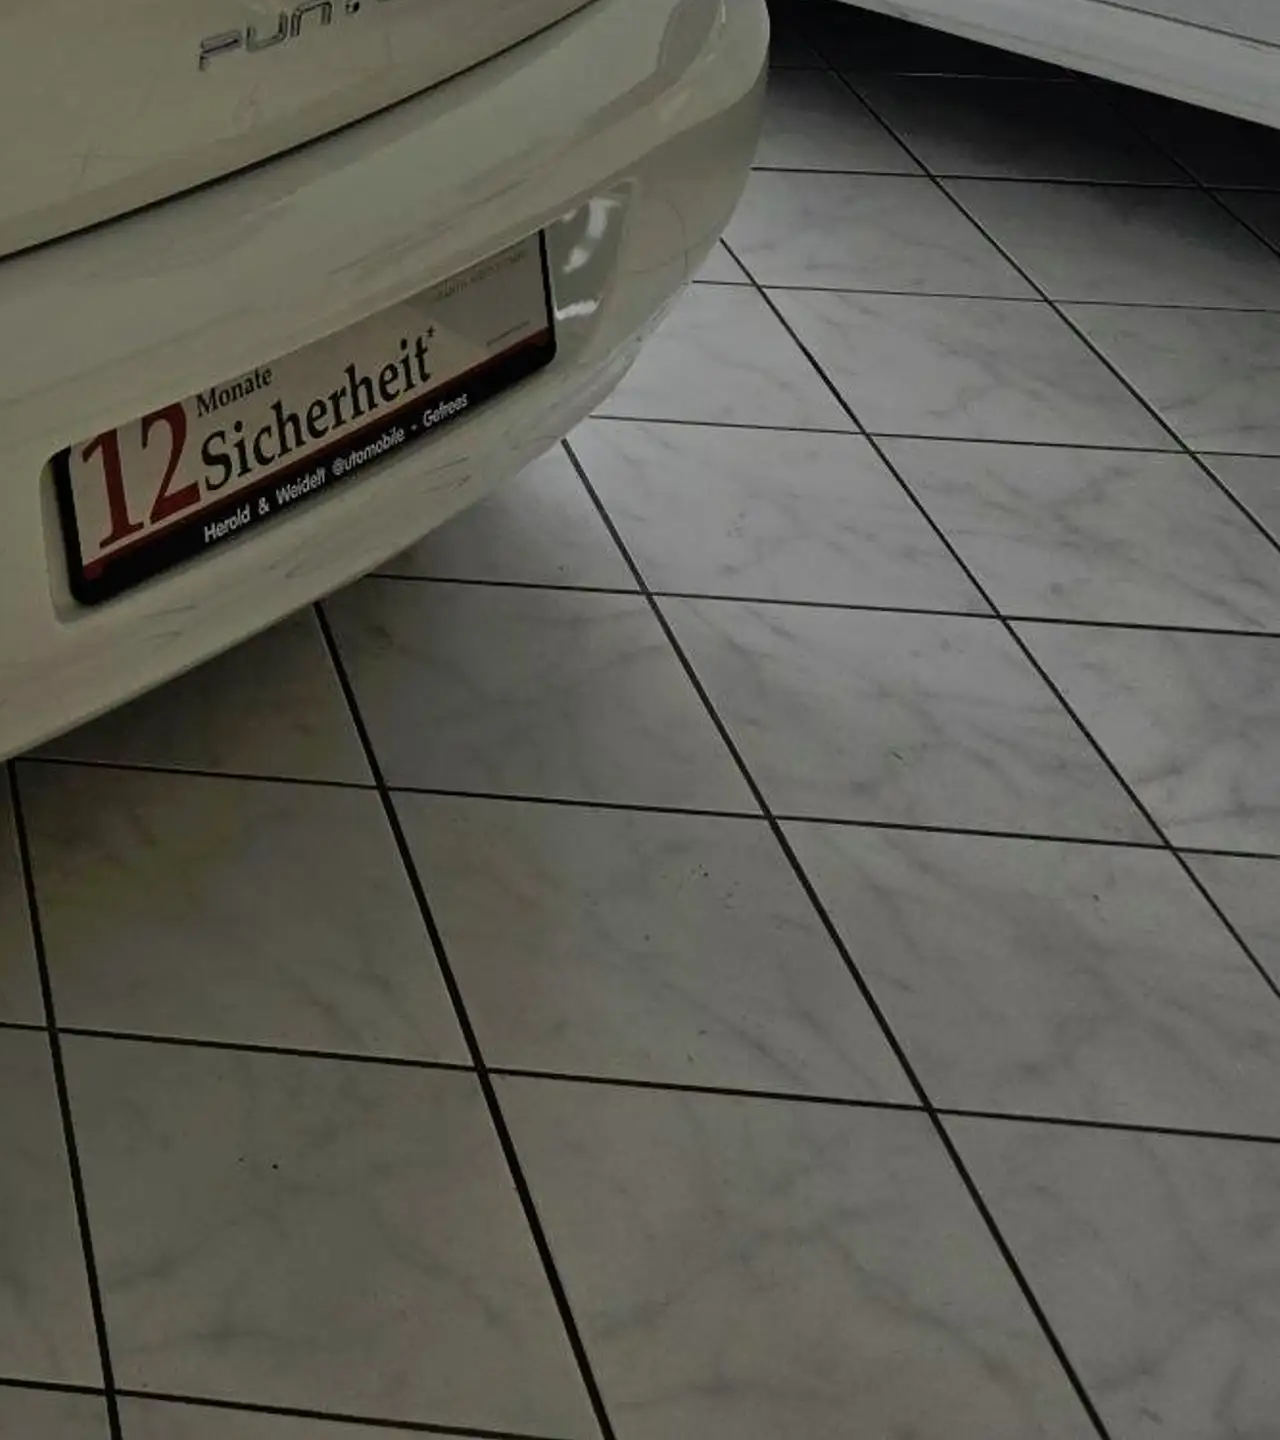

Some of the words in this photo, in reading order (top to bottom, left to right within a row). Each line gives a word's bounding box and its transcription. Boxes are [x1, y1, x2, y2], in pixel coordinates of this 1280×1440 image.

[81, 402, 202, 551] 12
[195, 364, 274, 418] Monate
[204, 500, 252, 543] Herold
[257, 496, 271, 515] &
